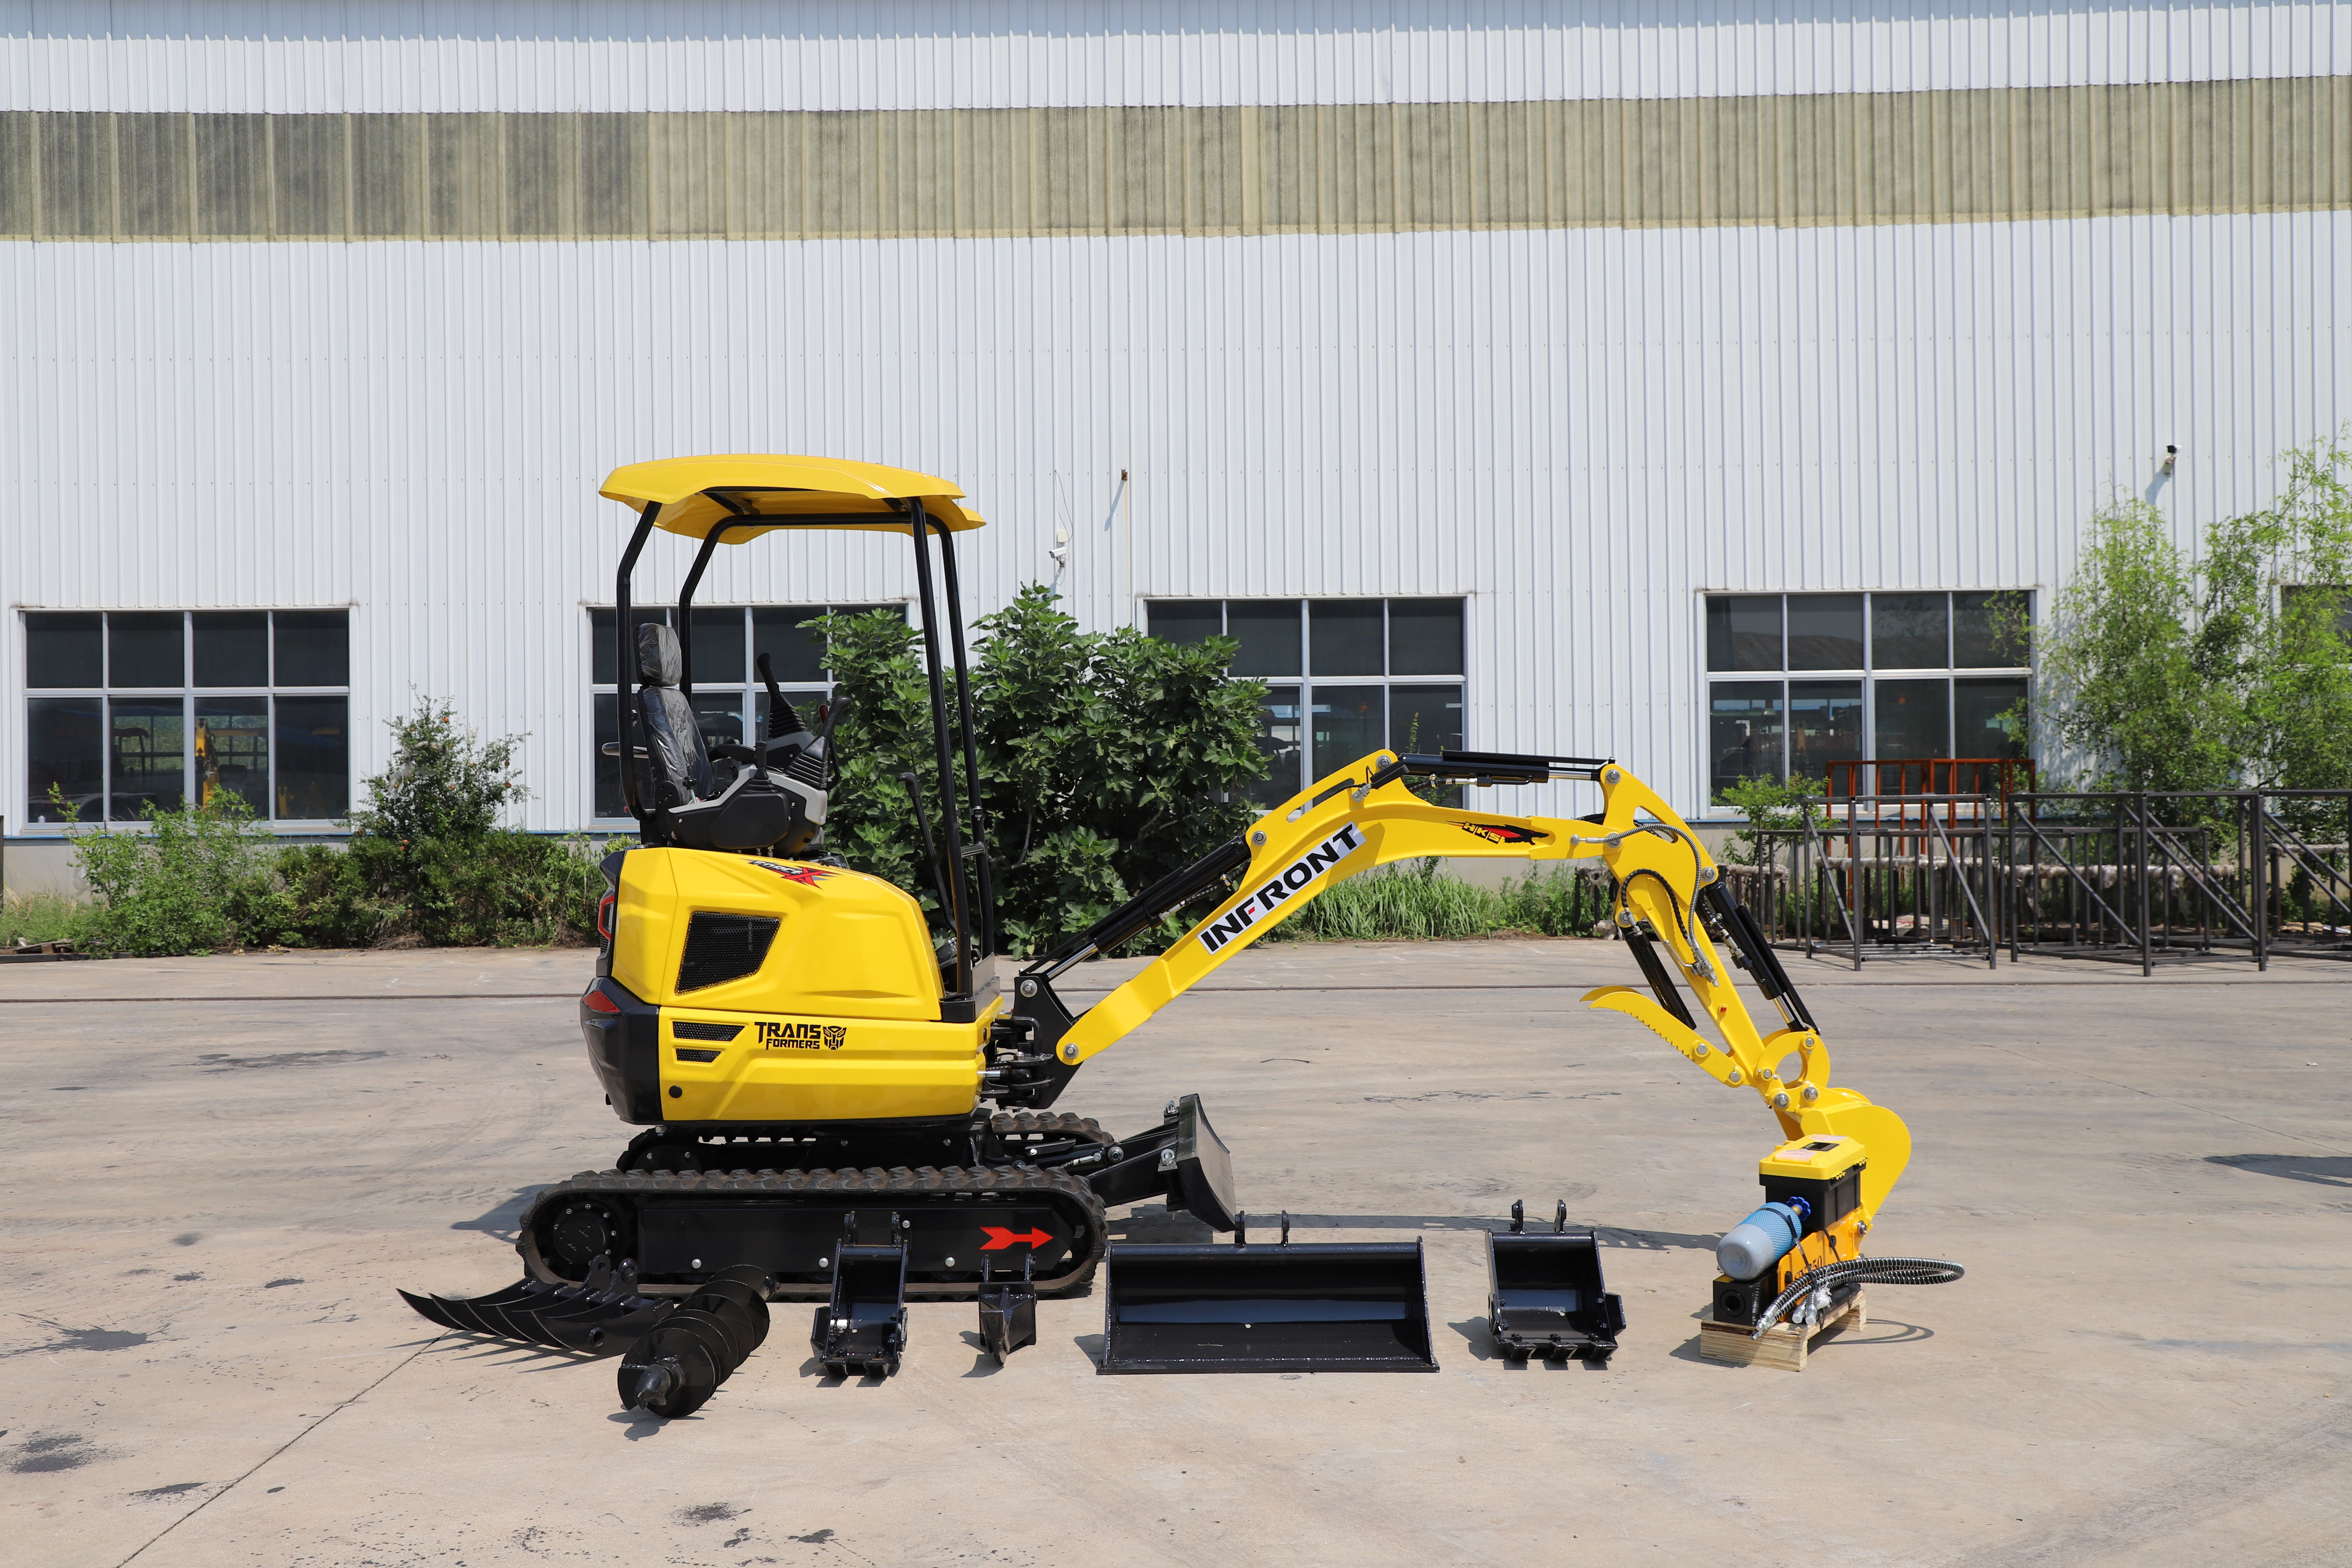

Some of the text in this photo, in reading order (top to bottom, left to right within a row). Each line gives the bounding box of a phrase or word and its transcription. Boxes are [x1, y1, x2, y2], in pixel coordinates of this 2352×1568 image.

[754, 861, 803, 875] FORCE
[1200, 824, 1357, 952] INFRONT
[754, 1021, 821, 1044] TRANS
[766, 1038, 820, 1051] FORMERS
